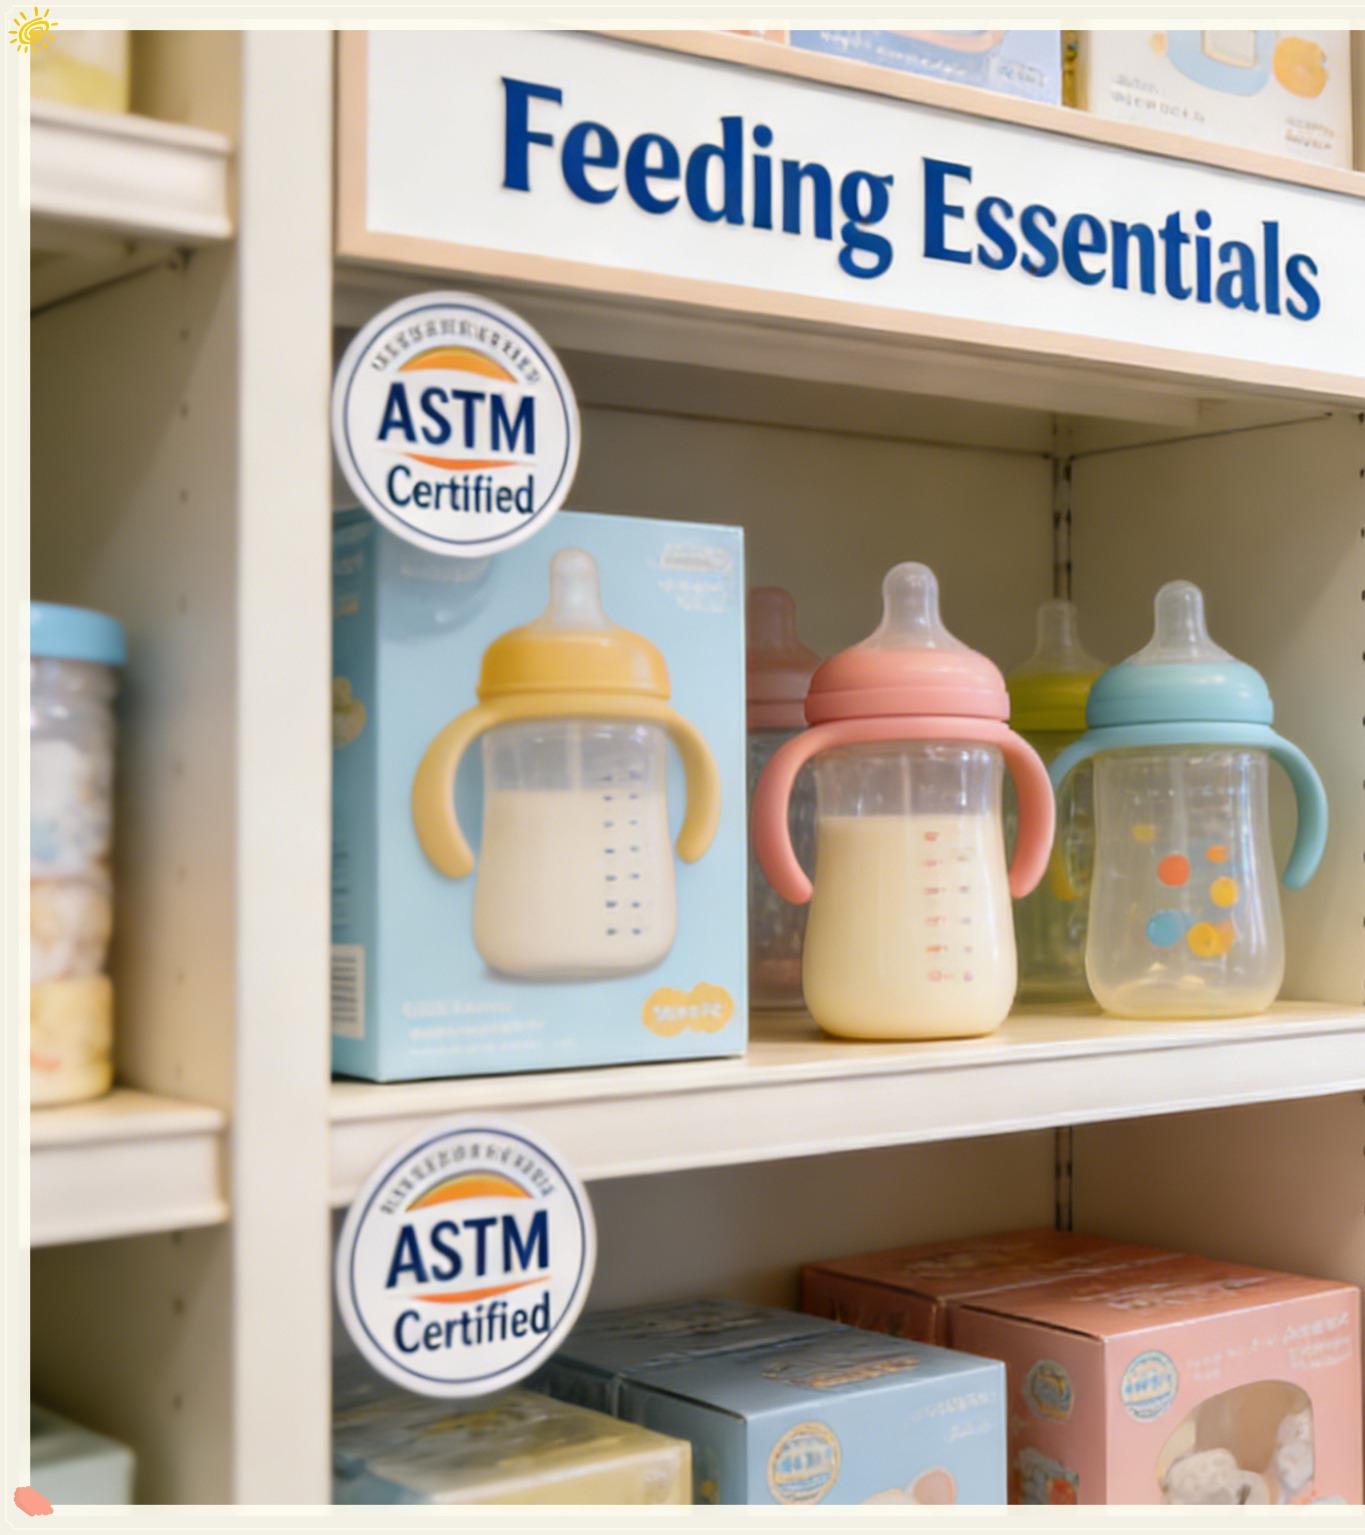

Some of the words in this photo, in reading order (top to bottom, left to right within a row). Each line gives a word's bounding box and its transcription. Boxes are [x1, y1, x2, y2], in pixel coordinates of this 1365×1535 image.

[501, 77, 894, 279] Feeding
[922, 157, 1320, 321] Essentials
[377, 382, 535, 455] ASTM
[387, 465, 534, 514] Certified
[385, 1209, 549, 1289] ASTM
[394, 1291, 550, 1354] Certified
